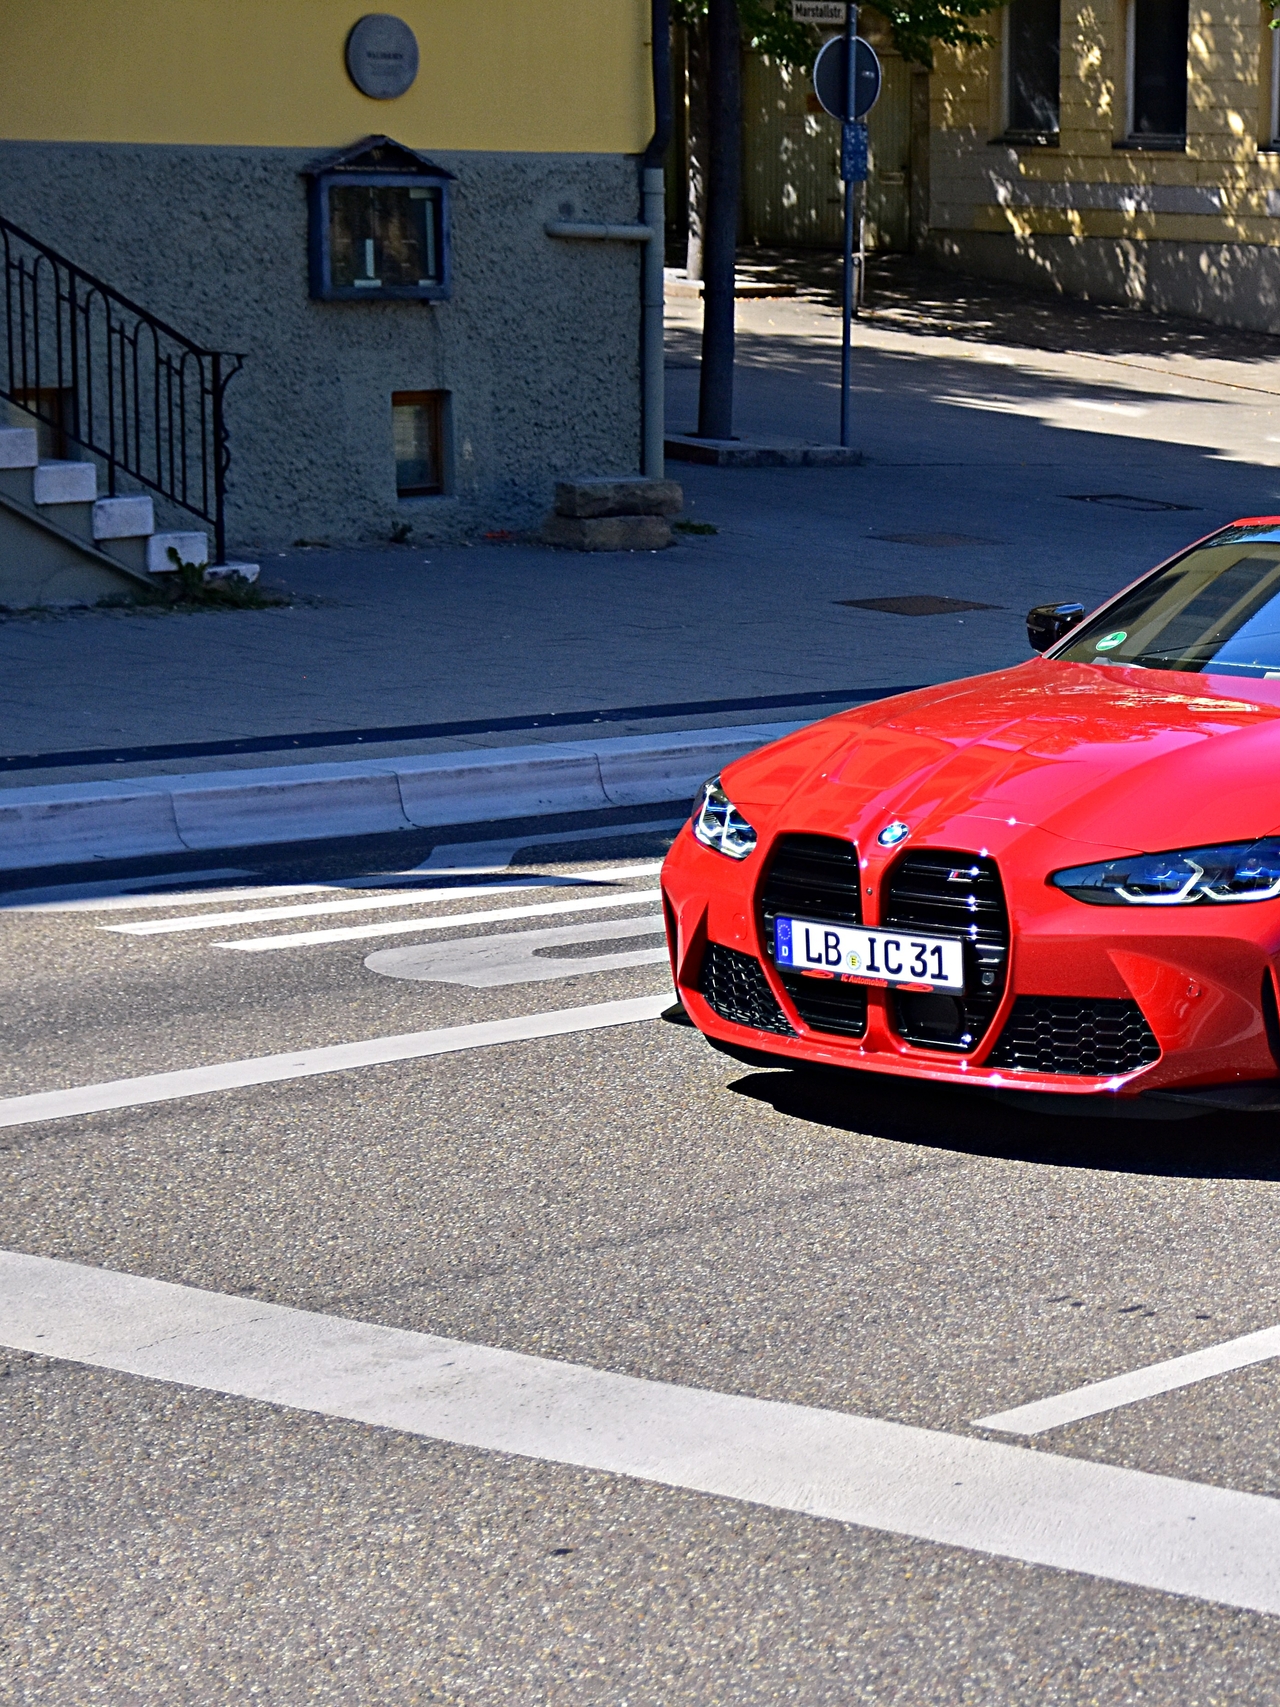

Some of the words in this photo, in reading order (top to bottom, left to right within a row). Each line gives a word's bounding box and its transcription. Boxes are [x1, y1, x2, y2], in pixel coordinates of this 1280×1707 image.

[795, 4, 844, 19] Marstallstr.
[782, 946, 789, 956] D
[804, 927, 842, 968] LB
[865, 936, 903, 974] IC
[909, 942, 949, 981] 31
[840, 973, 848, 982] IC
[848, 975, 889, 988] Automobile
